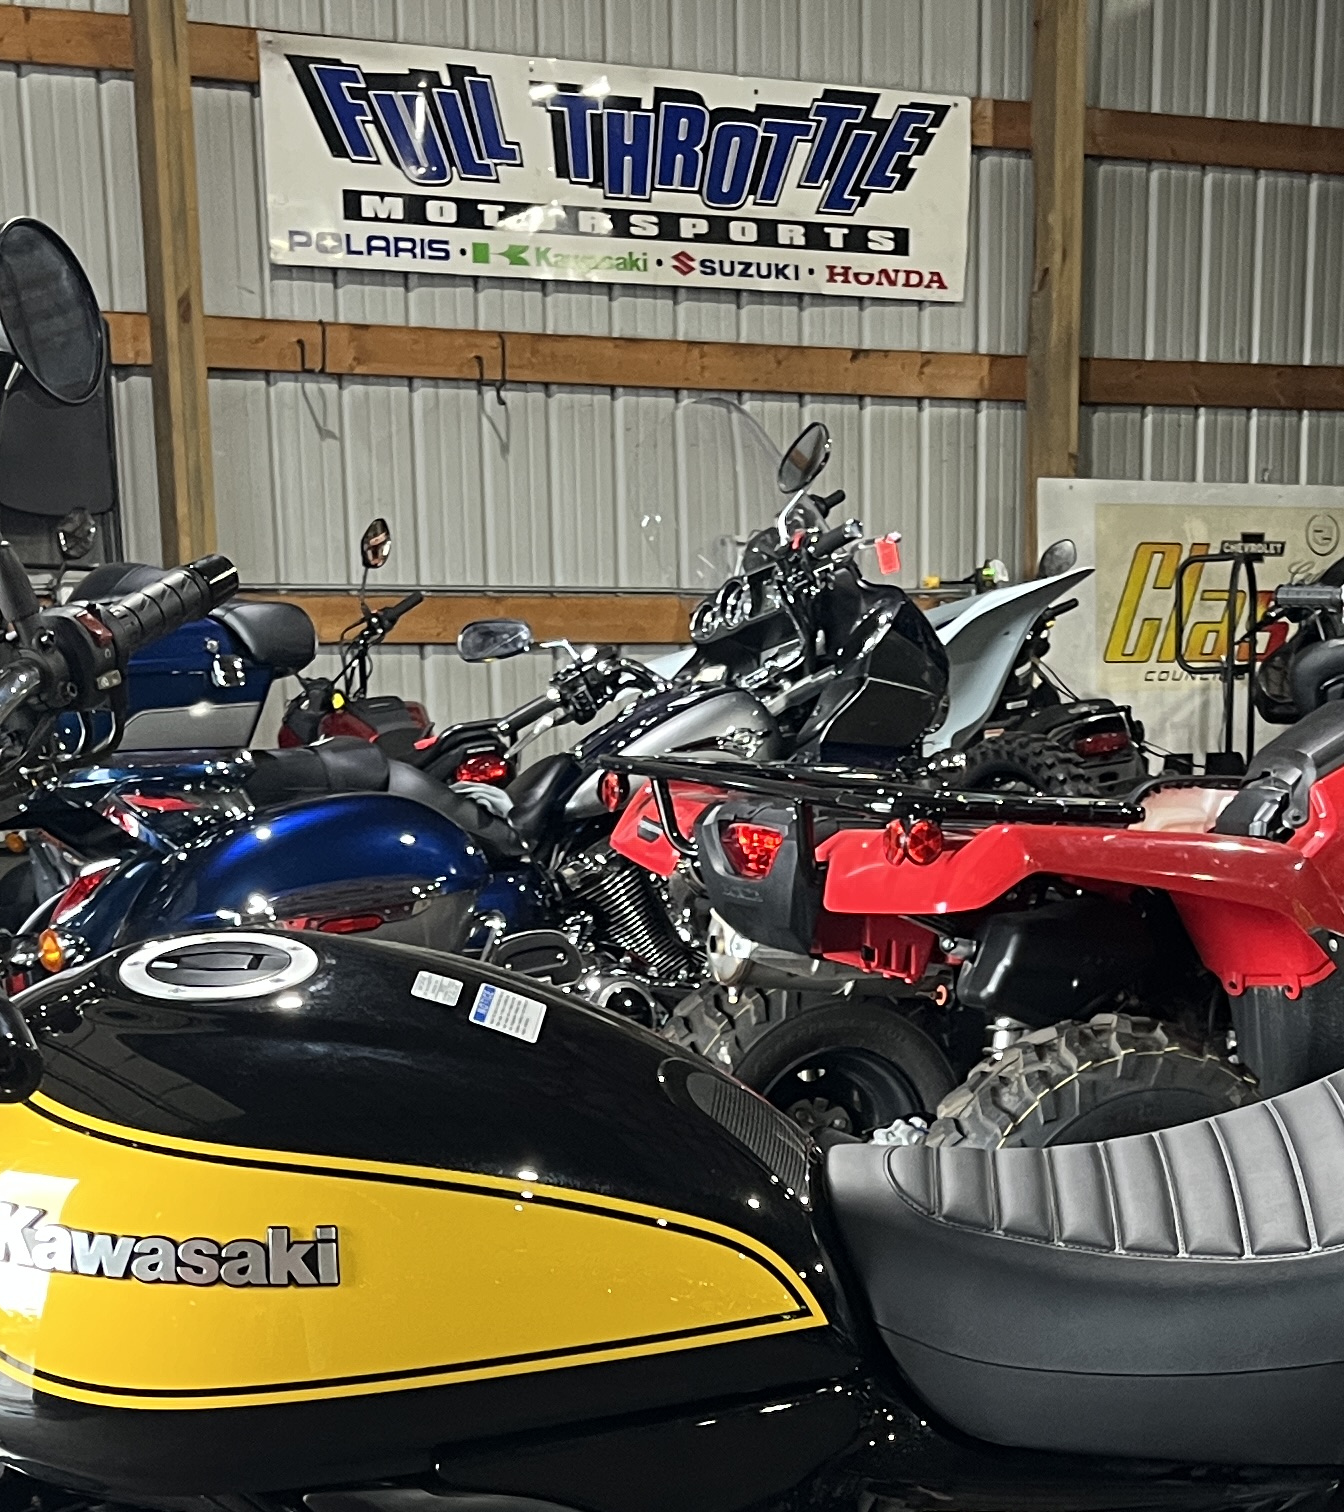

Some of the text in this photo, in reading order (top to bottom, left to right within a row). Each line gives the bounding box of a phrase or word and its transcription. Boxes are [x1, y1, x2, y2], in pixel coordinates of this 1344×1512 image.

[286, 55, 952, 215] FULL THROTTLE
[360, 195, 896, 251] MOTRSPORTS
[288, 230, 450, 261] POLARIS
[699, 258, 800, 281] SUZUKI
[825, 264, 949, 290] HONDA
[1221, 541, 1283, 554] CHEVROLET
